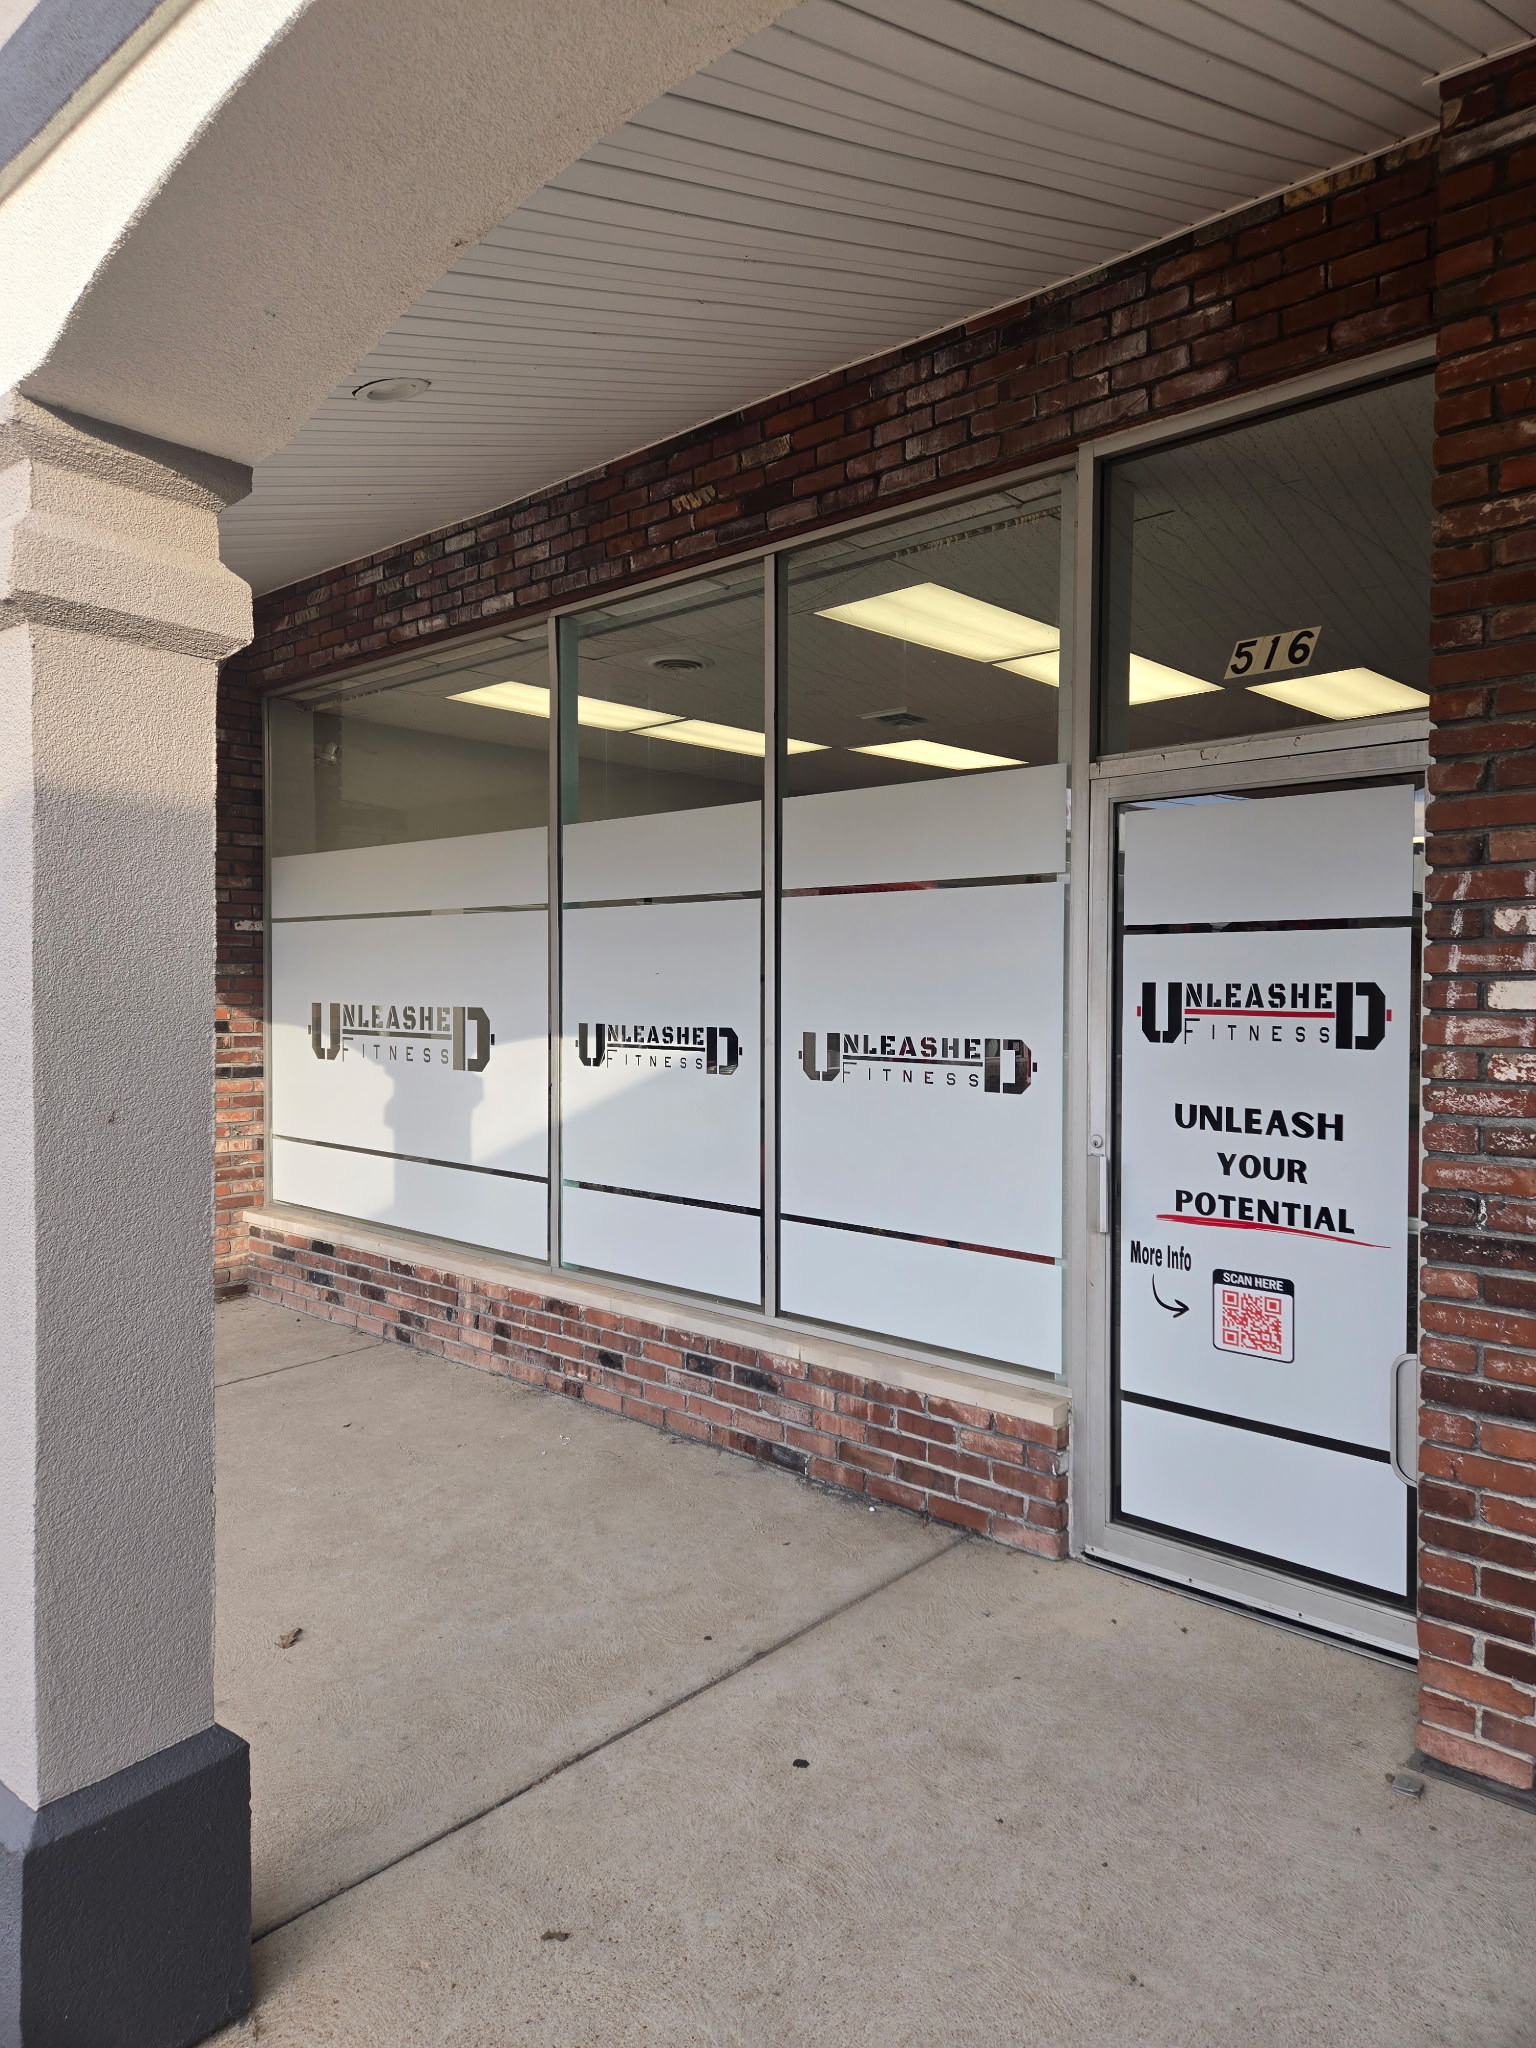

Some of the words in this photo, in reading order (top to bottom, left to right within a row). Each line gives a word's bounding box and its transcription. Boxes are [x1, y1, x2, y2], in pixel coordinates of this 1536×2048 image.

[1230, 630, 1315, 675] 516
[1141, 981, 1386, 1051] UNLEASHED
[1184, 1017, 1330, 1045] FITNESS
[311, 1002, 491, 1073] UNLEASHED
[342, 1036, 449, 1065] FITNESS
[578, 1022, 739, 1076] UNLEASHED
[606, 1049, 704, 1070] FITNESS
[802, 1031, 1032, 1095] UNLEASHED
[842, 1061, 980, 1088] FITNESS
[1174, 1102, 1344, 1142] UNLEASH
[1216, 1151, 1309, 1185] YOUR
[1174, 1189, 1356, 1235] POTENTIAL
[1130, 1240, 1163, 1267] More
[1167, 1245, 1192, 1271] Info
[1222, 1271, 1253, 1287] SCAN
[1254, 1276, 1284, 1291] HERE
